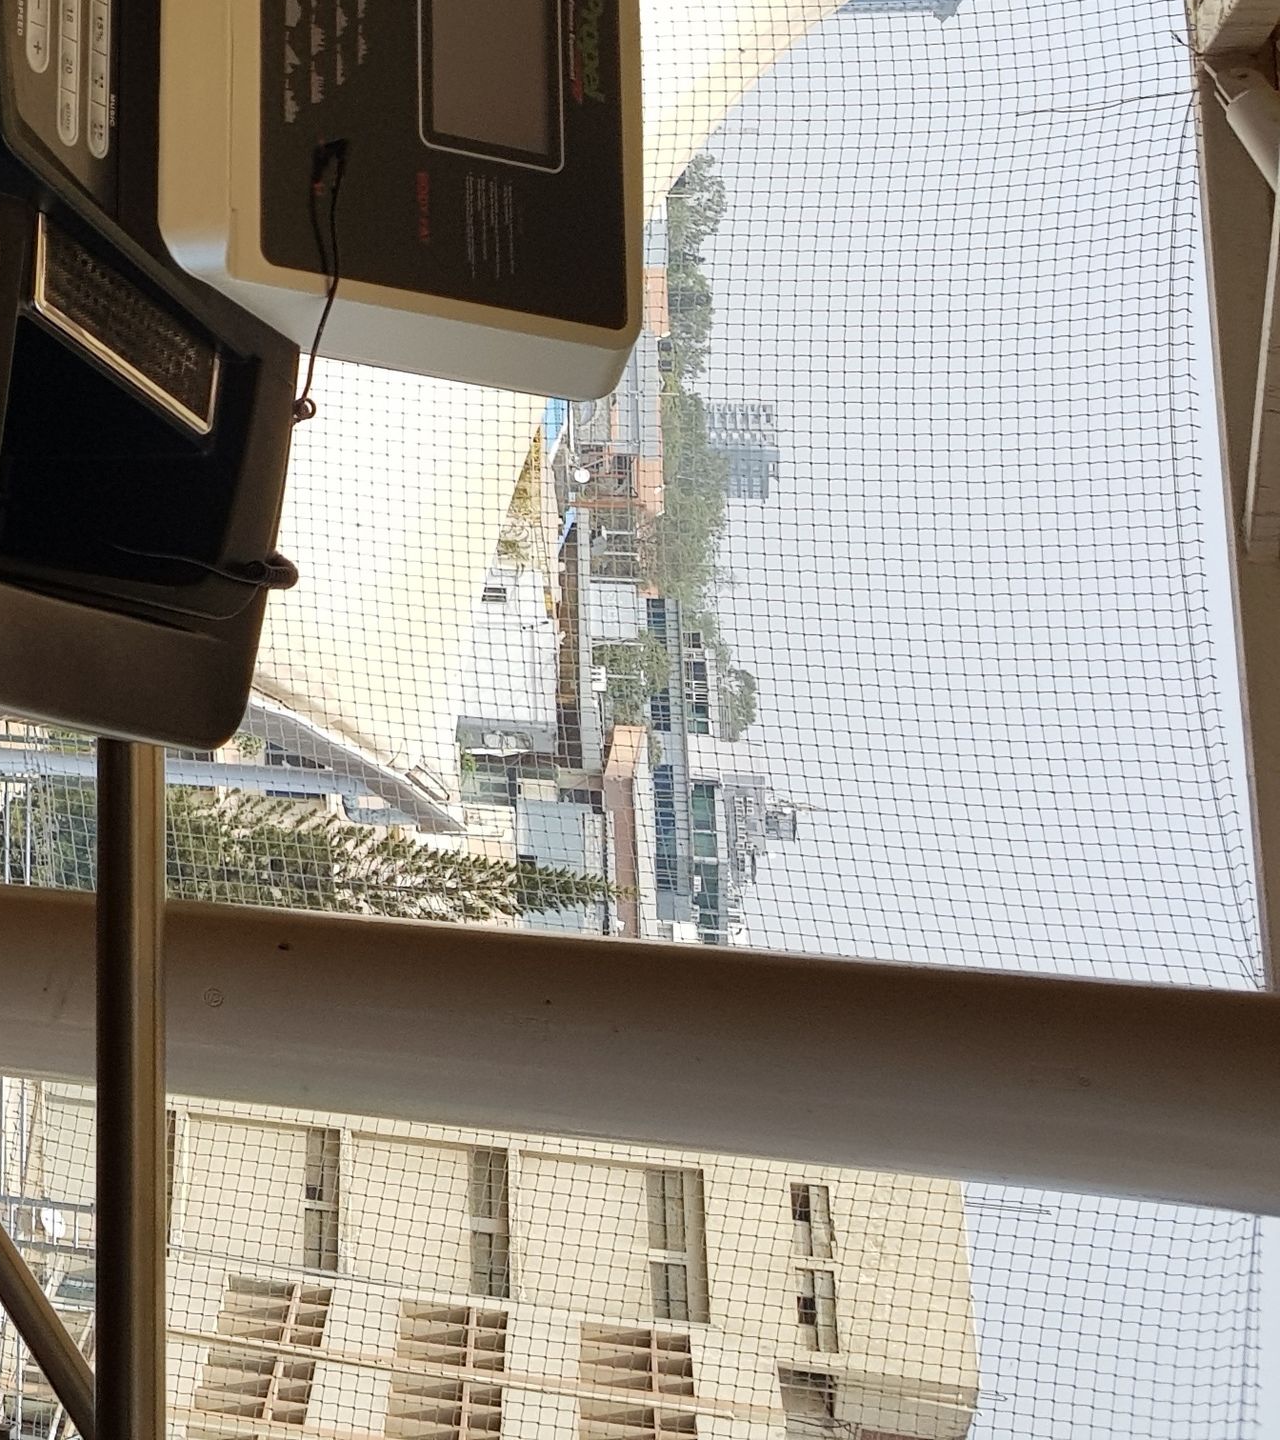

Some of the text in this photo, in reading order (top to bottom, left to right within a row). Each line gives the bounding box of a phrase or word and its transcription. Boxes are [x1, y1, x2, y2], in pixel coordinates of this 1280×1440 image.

[16, 0, 25, 37] SPEED
[65, 8, 74, 24] 18
[95, 16, 104, 42] 15%
[64, 58, 73, 75] 20
[109, 93, 117, 128] MUSIC
